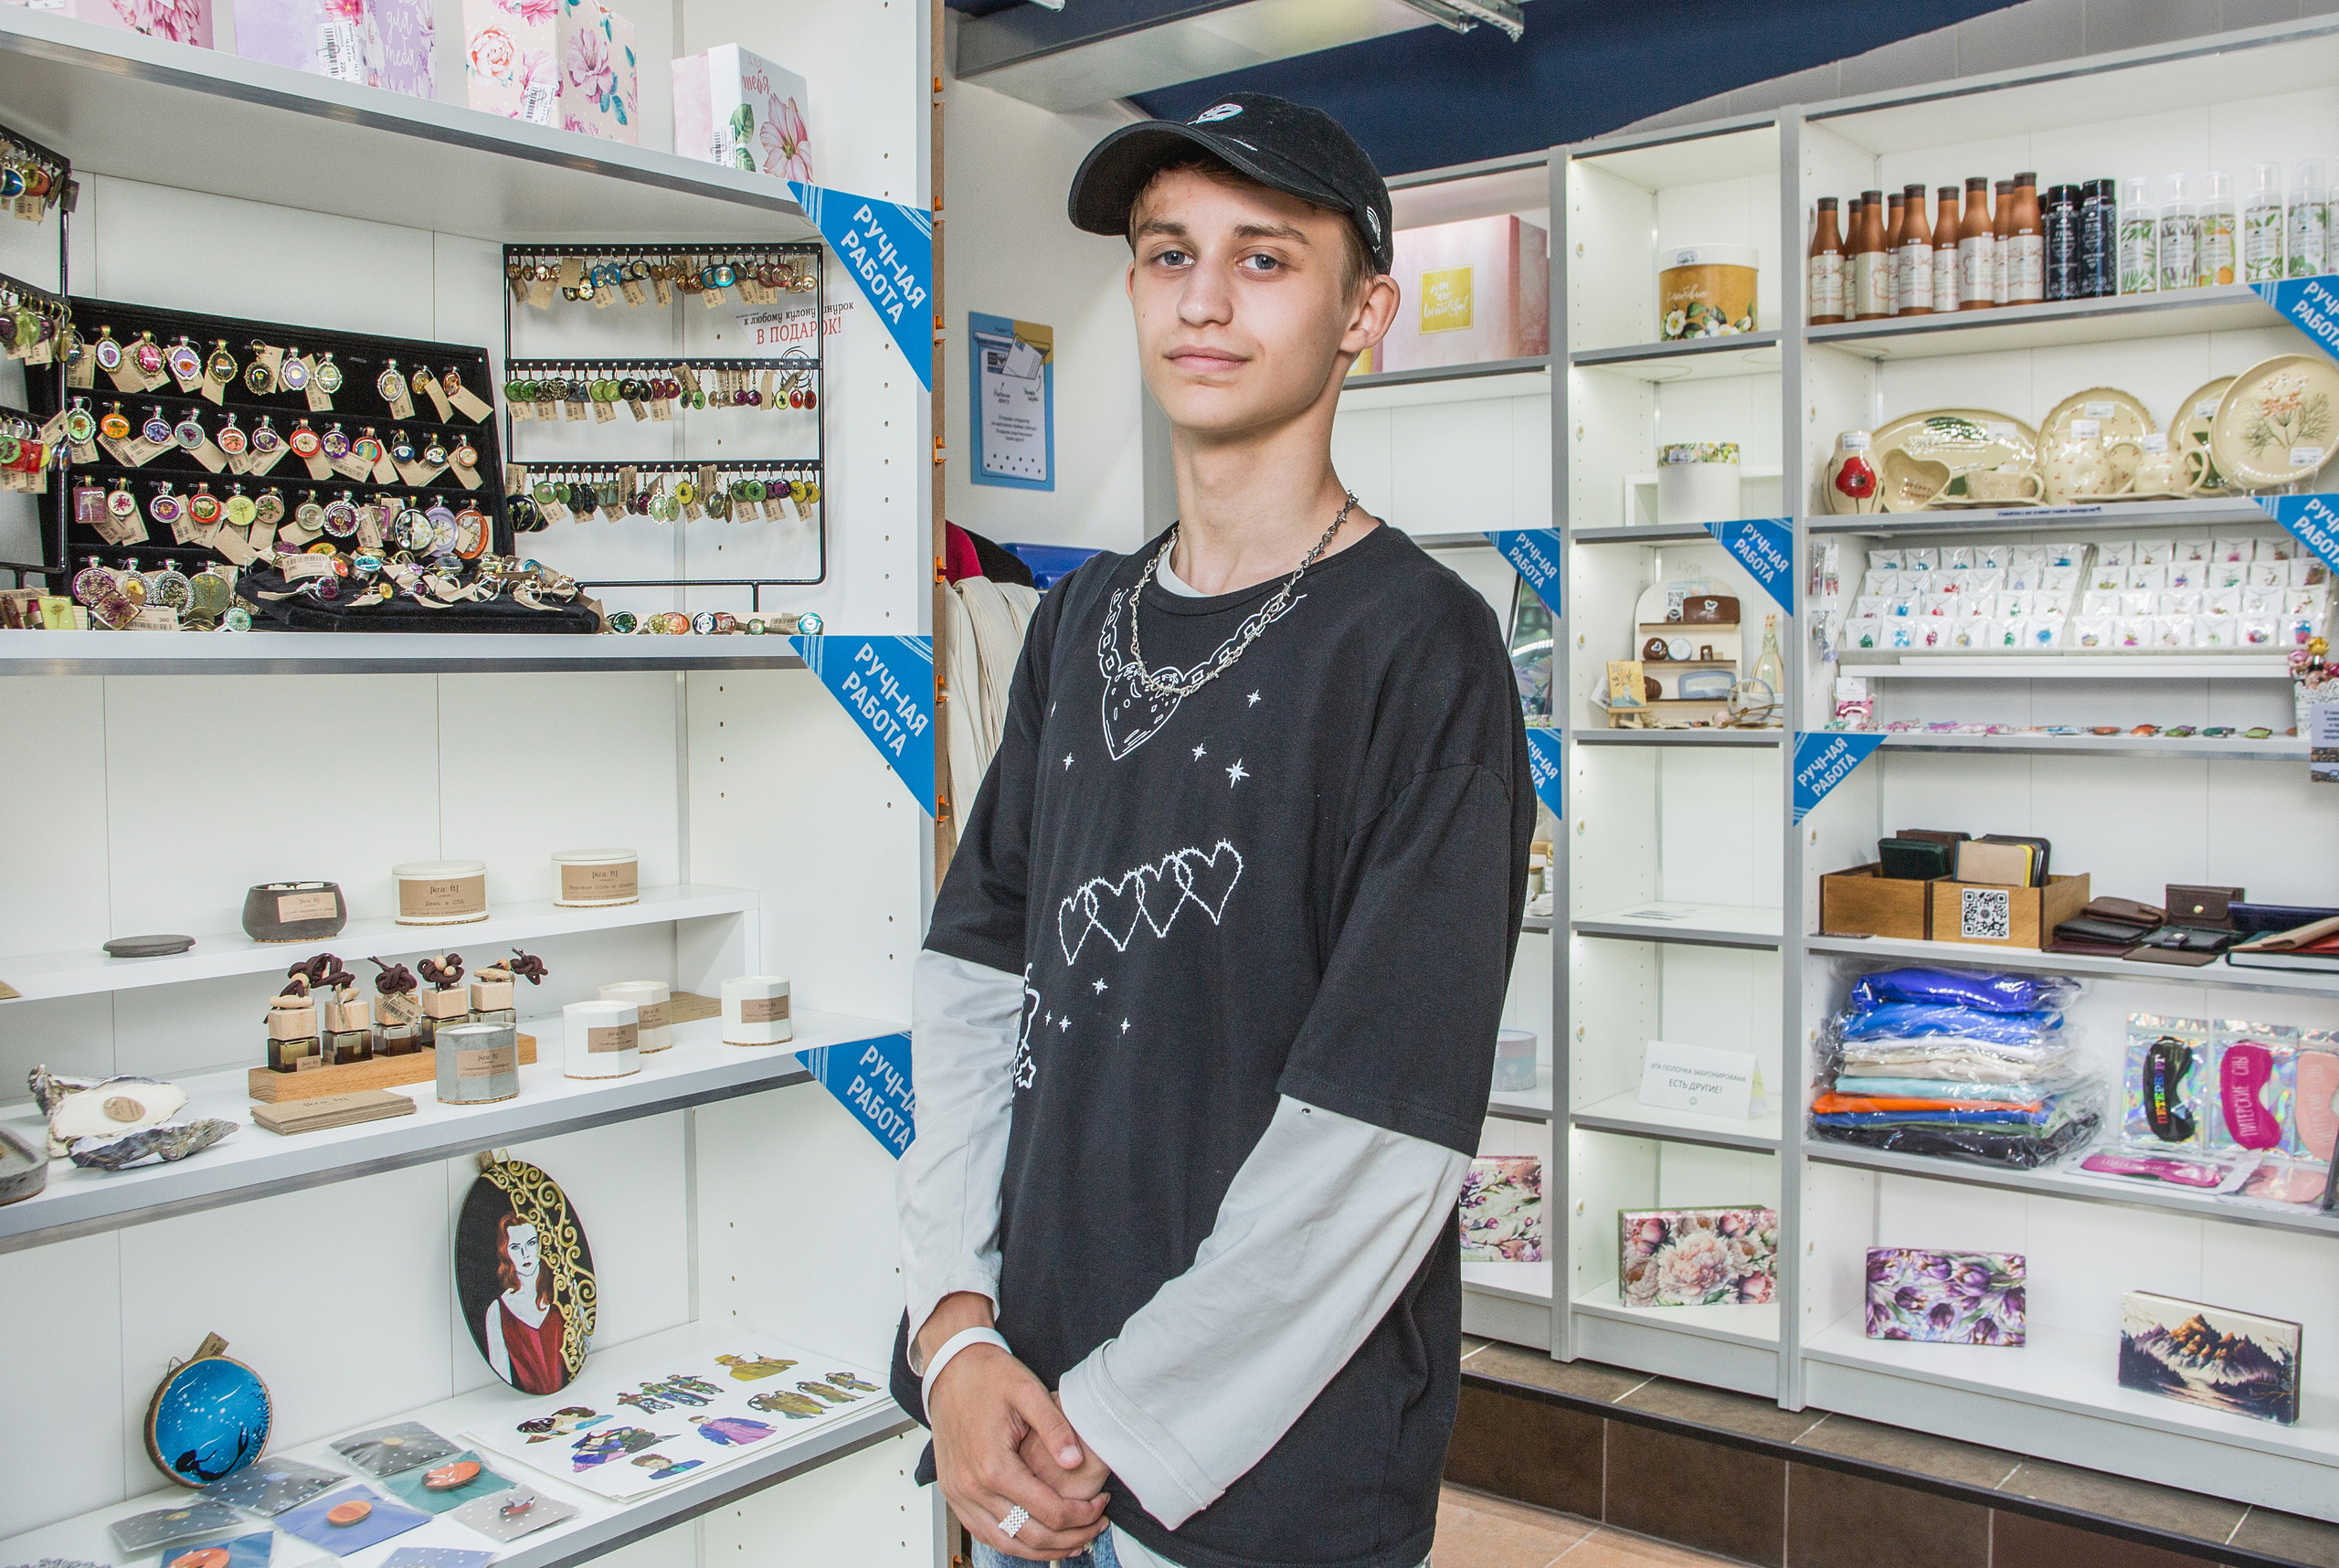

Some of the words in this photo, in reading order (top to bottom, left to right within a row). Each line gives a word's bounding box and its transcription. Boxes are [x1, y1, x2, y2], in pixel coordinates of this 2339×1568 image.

[386, 8, 413, 46] для
[384, 35, 418, 73] тебя
[742, 69, 771, 95] тебя
[841, 228, 905, 325] РАБОТА
[853, 204, 926, 310] РУЧНАЯ
[751, 313, 783, 325] любому
[786, 307, 817, 322] кулону
[1424, 294, 1469, 320] beautiful
[1436, 291, 1451, 302] are
[757, 329, 765, 345] В
[1508, 546, 1546, 588] РАБОТА
[1515, 532, 1558, 579] РУЧНАЯ
[1733, 538, 1775, 584] РАБОТА
[1741, 523, 1789, 574] РУЧНАЯ
[854, 642, 928, 737] РУЧНАЯ
[841, 671, 907, 758] РАБОТА
[1527, 736, 1559, 780] УЧНАЯ
[1796, 736, 1848, 788] РУЧНАЯ
[1811, 753, 1858, 798] РАБОТА
[429, 885, 448, 895] [kra:
[450, 885, 459, 894] ft]
[592, 870, 609, 879] [kra:
[609, 869, 619, 877] ft]
[859, 1044, 916, 1118] РУЧНА
[1662, 1064, 1692, 1075] ПОЛОЧКА
[1693, 1069, 1747, 1082] ЗАБРОНИРОВАНА
[1668, 1078, 1688, 1089] ЕСТЬ
[1688, 1082, 1723, 1095] ДРУГИЕ!
[2231, 1056, 2249, 1076] СНЫ
[2154, 1054, 2169, 1125] ПЕТЕРБУРГ
[2234, 1085, 2259, 1138] ПИТЕРСКИЕ
[846, 1075, 911, 1151] РАБОТА
